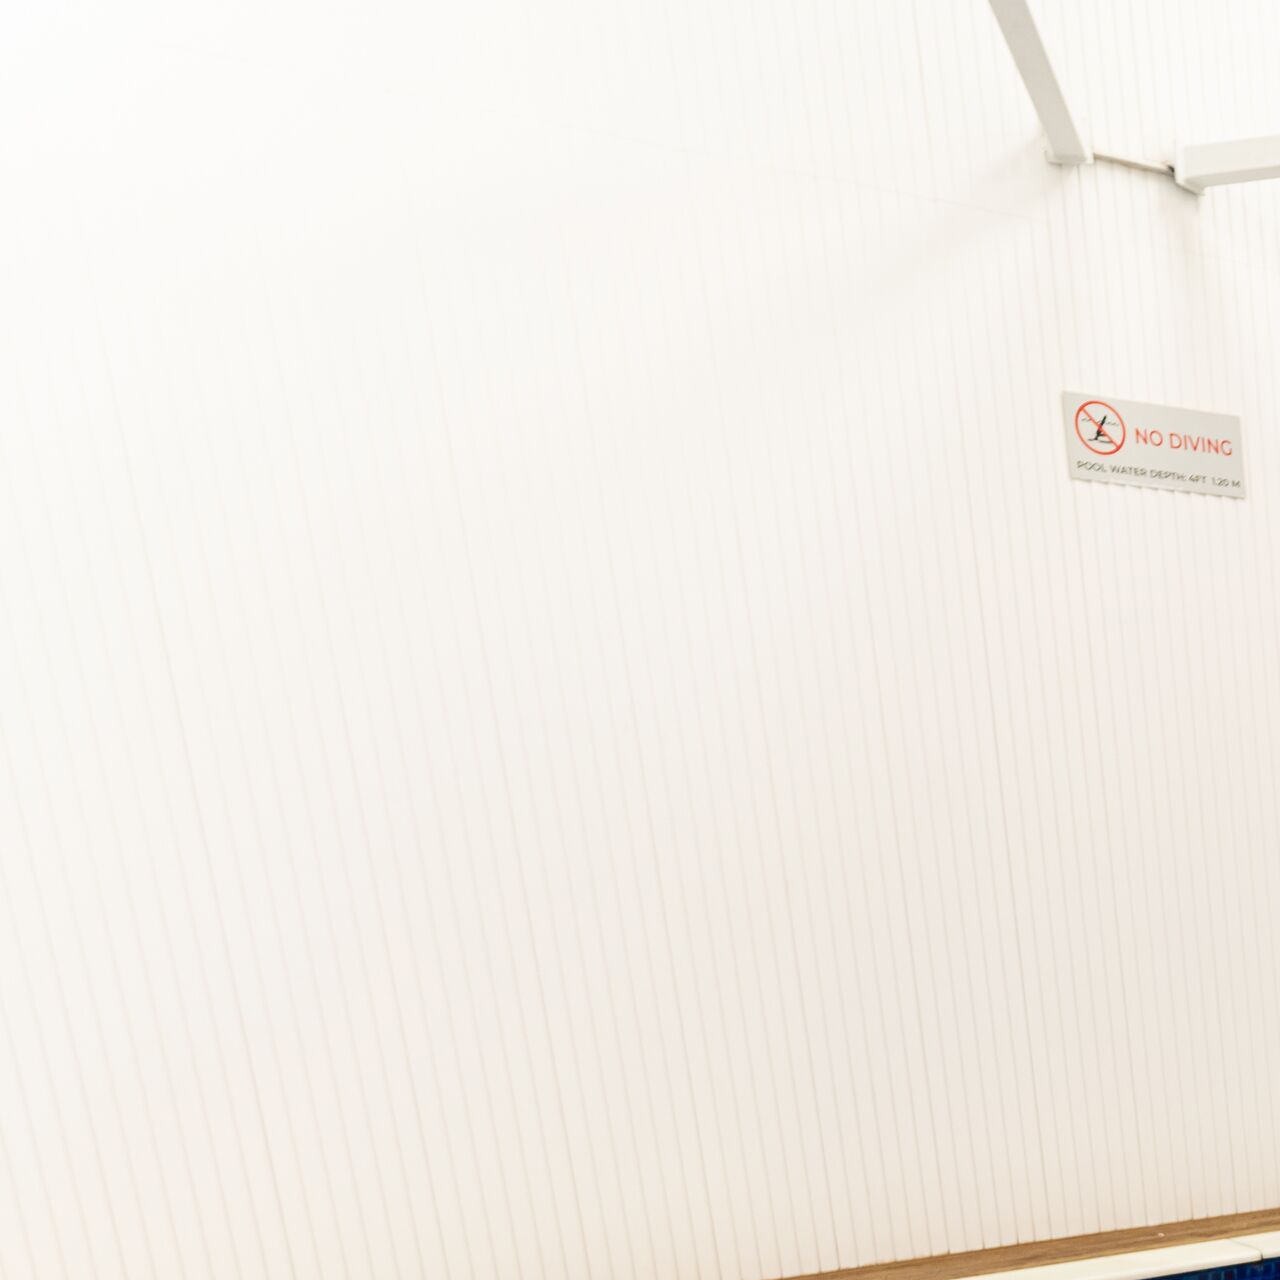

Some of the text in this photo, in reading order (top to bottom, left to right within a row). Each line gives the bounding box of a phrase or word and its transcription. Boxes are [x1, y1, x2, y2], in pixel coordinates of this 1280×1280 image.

[1135, 427, 1233, 457] NO DIVING
[1077, 460, 1107, 473] POOL
[1110, 464, 1147, 477] WATER
[1232, 480, 1241, 489] M
